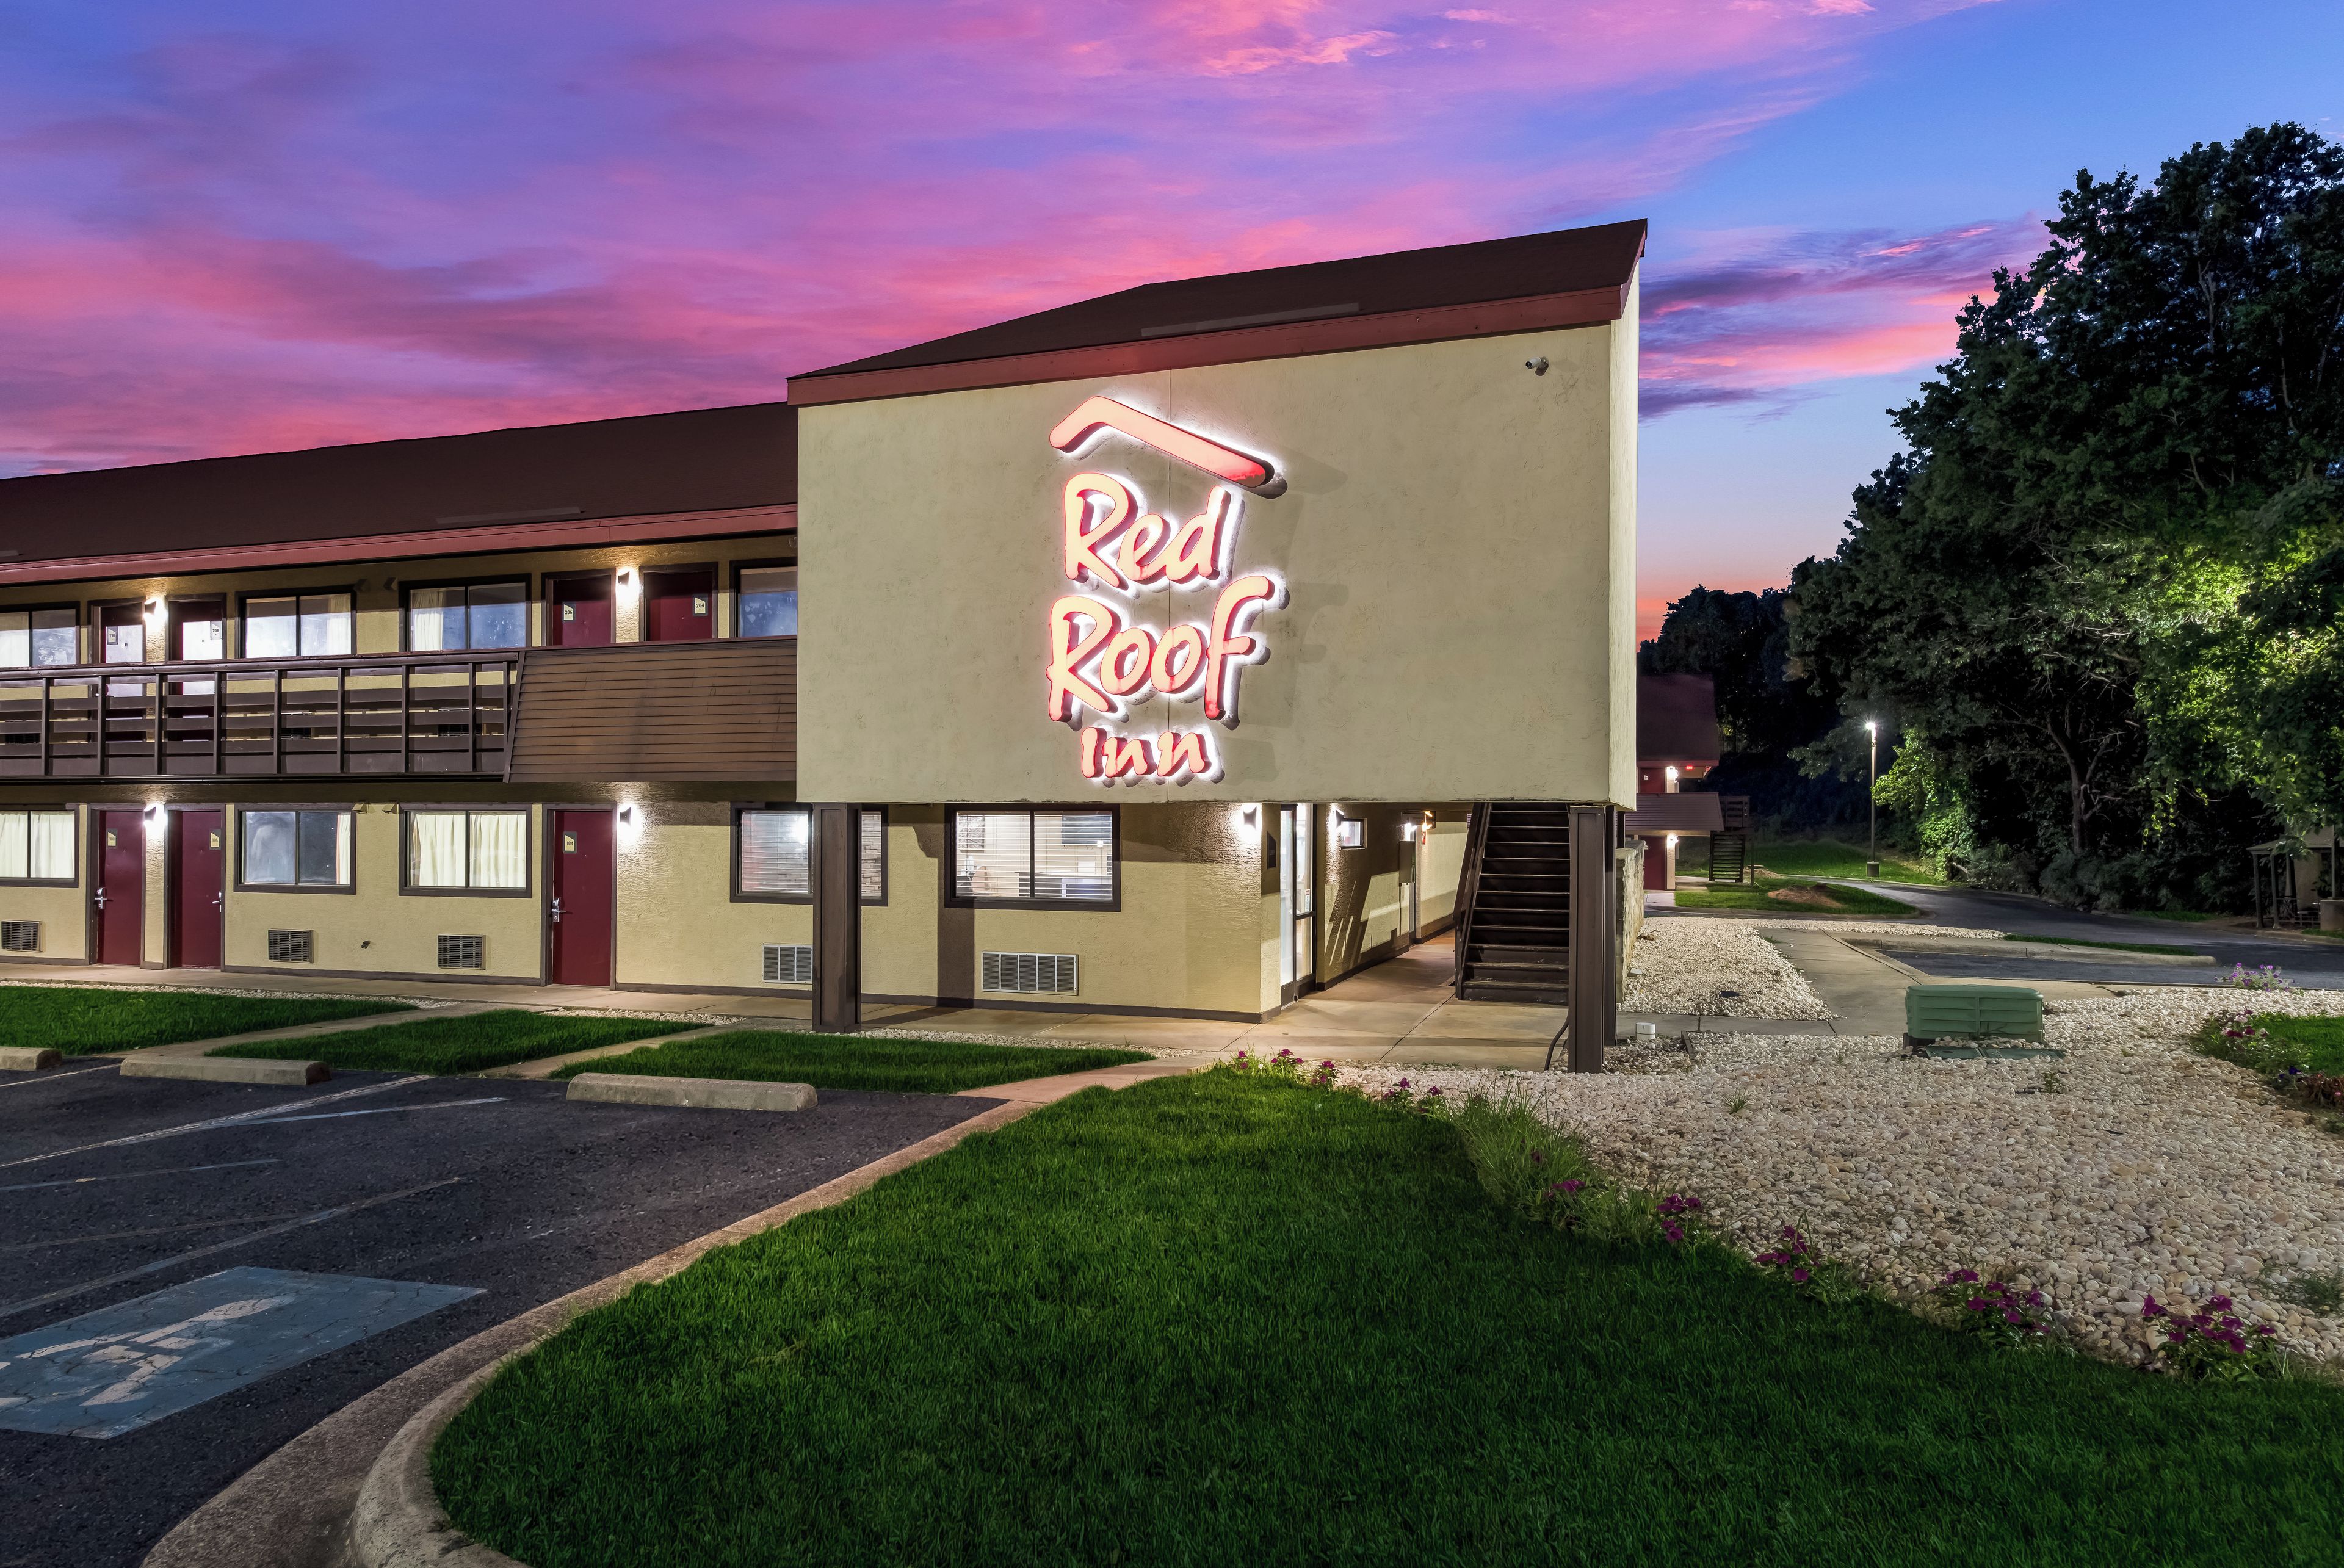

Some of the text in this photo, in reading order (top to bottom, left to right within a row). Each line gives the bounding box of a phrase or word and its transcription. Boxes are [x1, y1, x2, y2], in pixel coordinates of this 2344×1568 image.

[1064, 472, 1231, 590] Red
[1046, 576, 1275, 722] Roof
[1081, 726, 1213, 778] Inn
